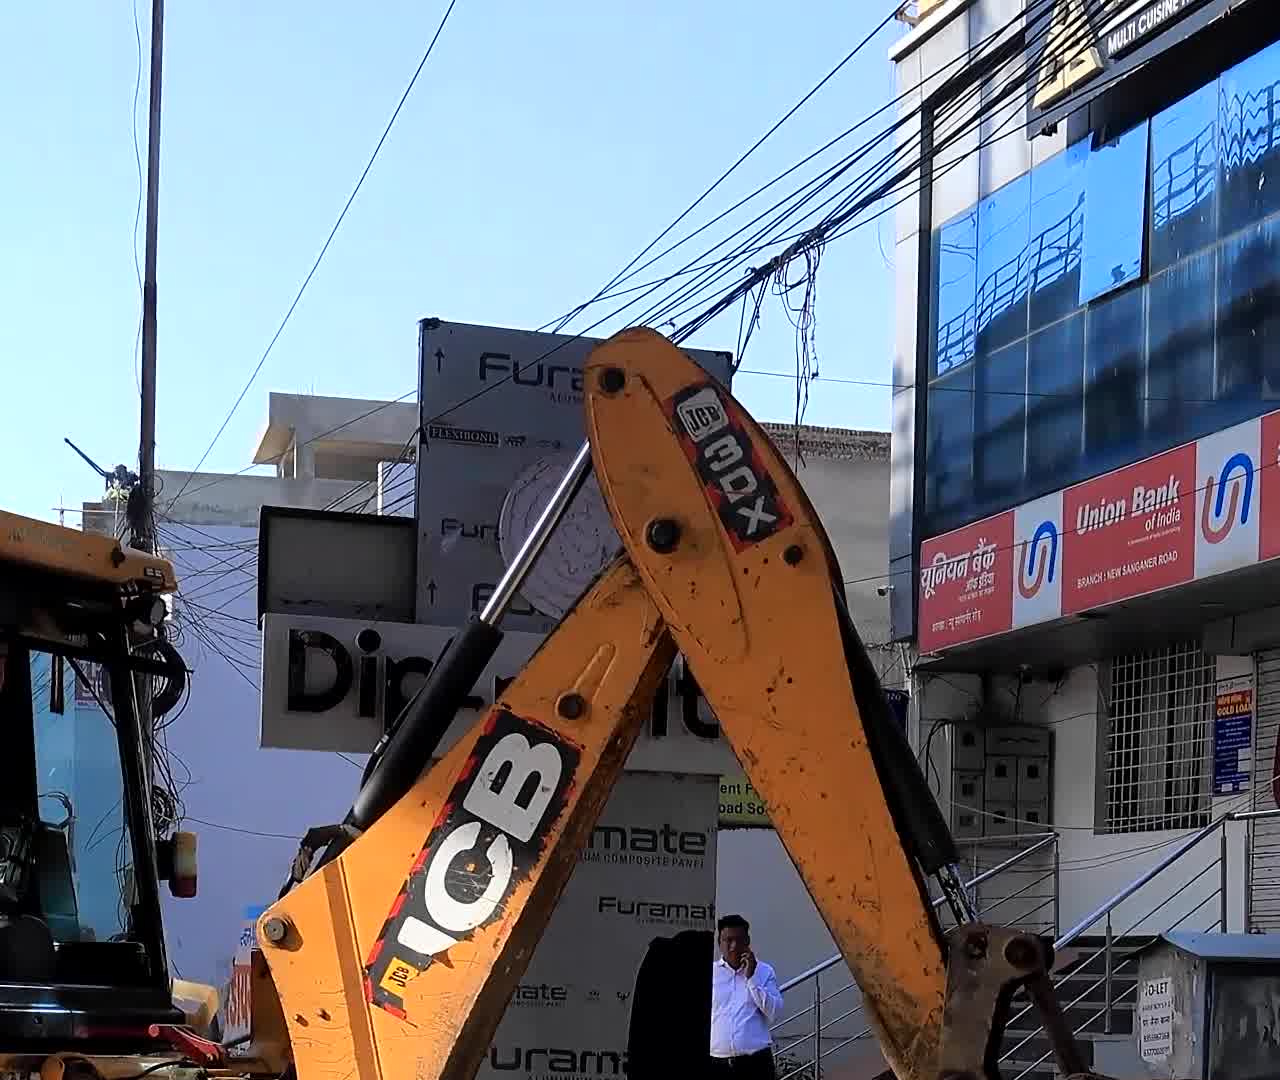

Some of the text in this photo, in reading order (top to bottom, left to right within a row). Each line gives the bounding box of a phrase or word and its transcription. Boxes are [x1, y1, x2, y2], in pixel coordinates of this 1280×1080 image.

[1108, 27, 1136, 54] MULTI
[685, 403, 721, 434] JCB
[431, 427, 499, 444] FLEXIBOND
[704, 434, 777, 537] 3DX
[1076, 474, 1180, 535] Union Bank
[1145, 506, 1181, 531] of India
[920, 552, 971, 599] यूनियन
[1077, 570, 1103, 589] BRANCH
[1107, 567, 1122, 581] NEW
[1122, 555, 1158, 576] SANGANER
[1158, 550, 1178, 566] ROAD
[603, 854, 670, 866] COMPOSITE
[387, 965, 411, 989] JCB
